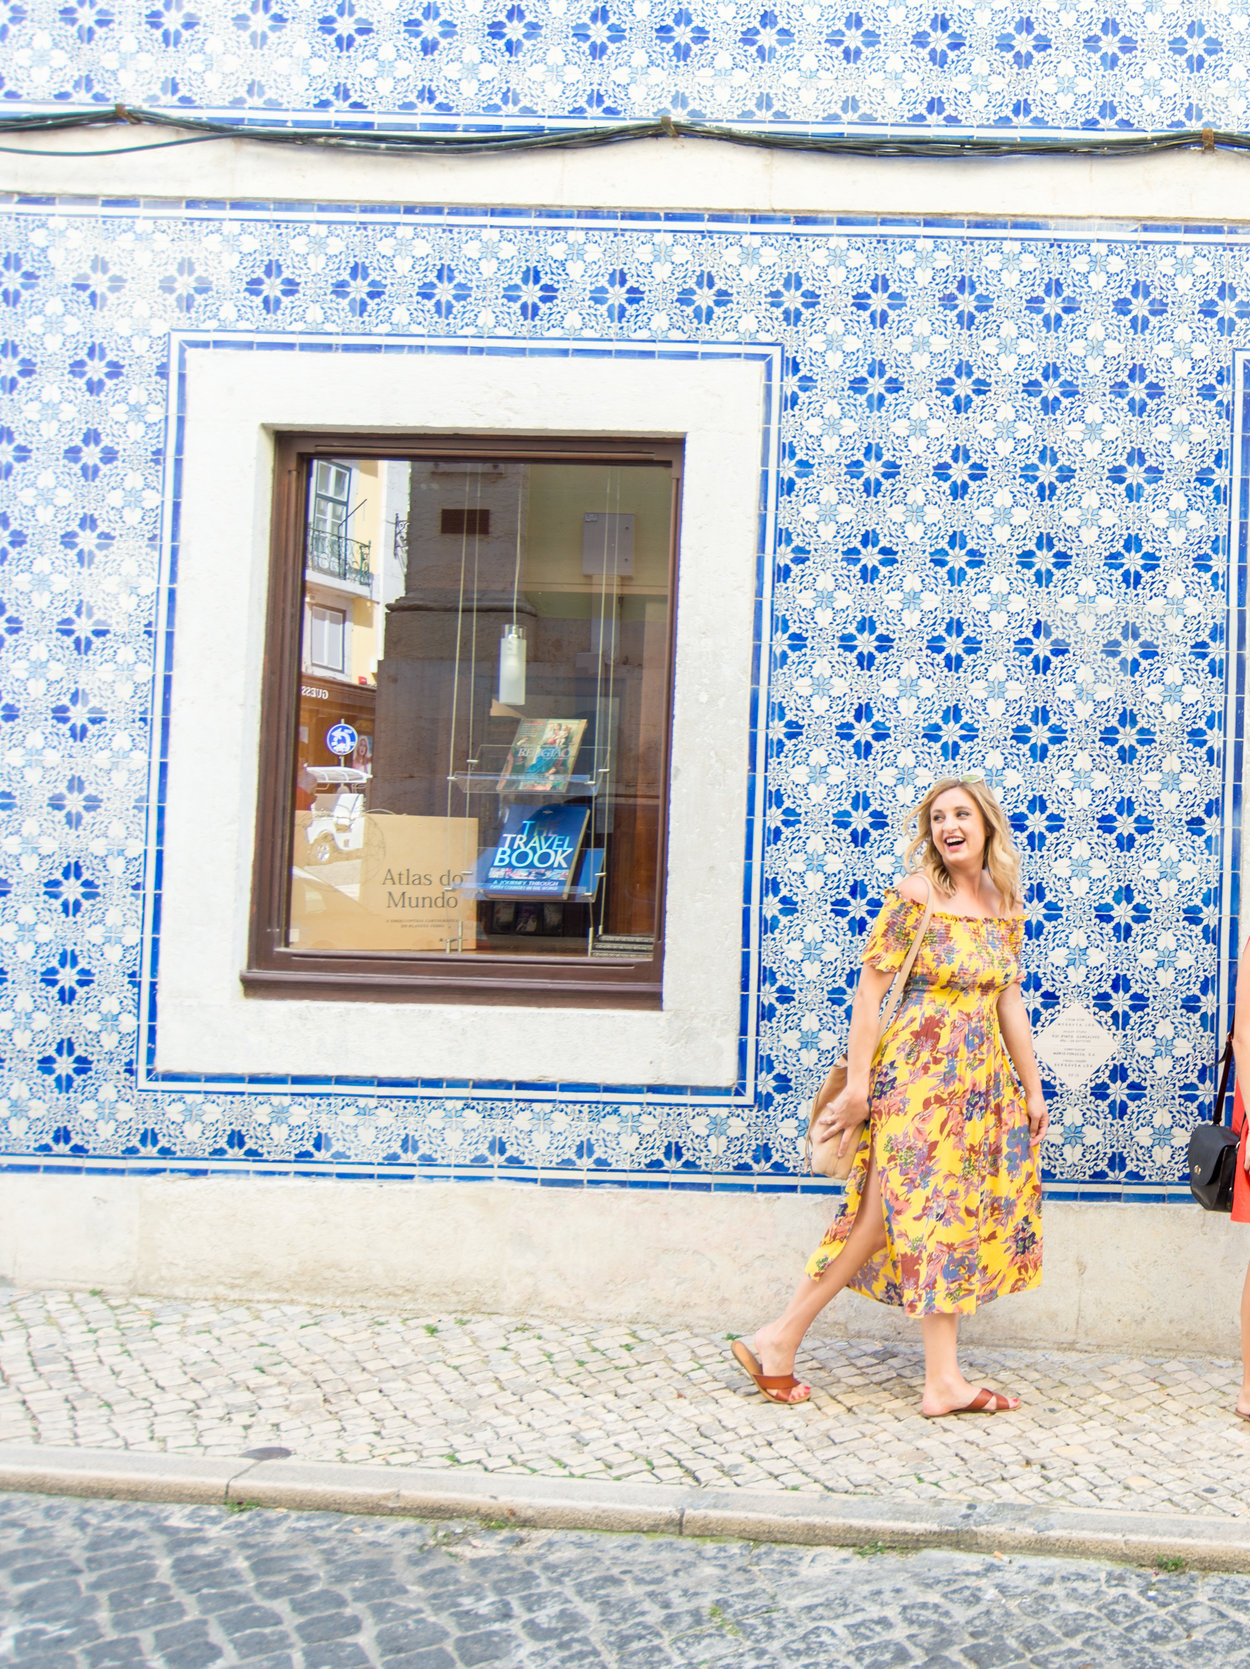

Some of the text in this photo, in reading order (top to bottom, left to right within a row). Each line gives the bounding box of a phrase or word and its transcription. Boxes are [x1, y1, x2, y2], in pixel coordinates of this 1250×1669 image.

[522, 820, 560, 836] THE
[503, 833, 574, 852] TRAVEL
[493, 847, 574, 868] BOOK
[382, 868, 464, 887] Atlas do
[387, 891, 458, 909] Mundo
